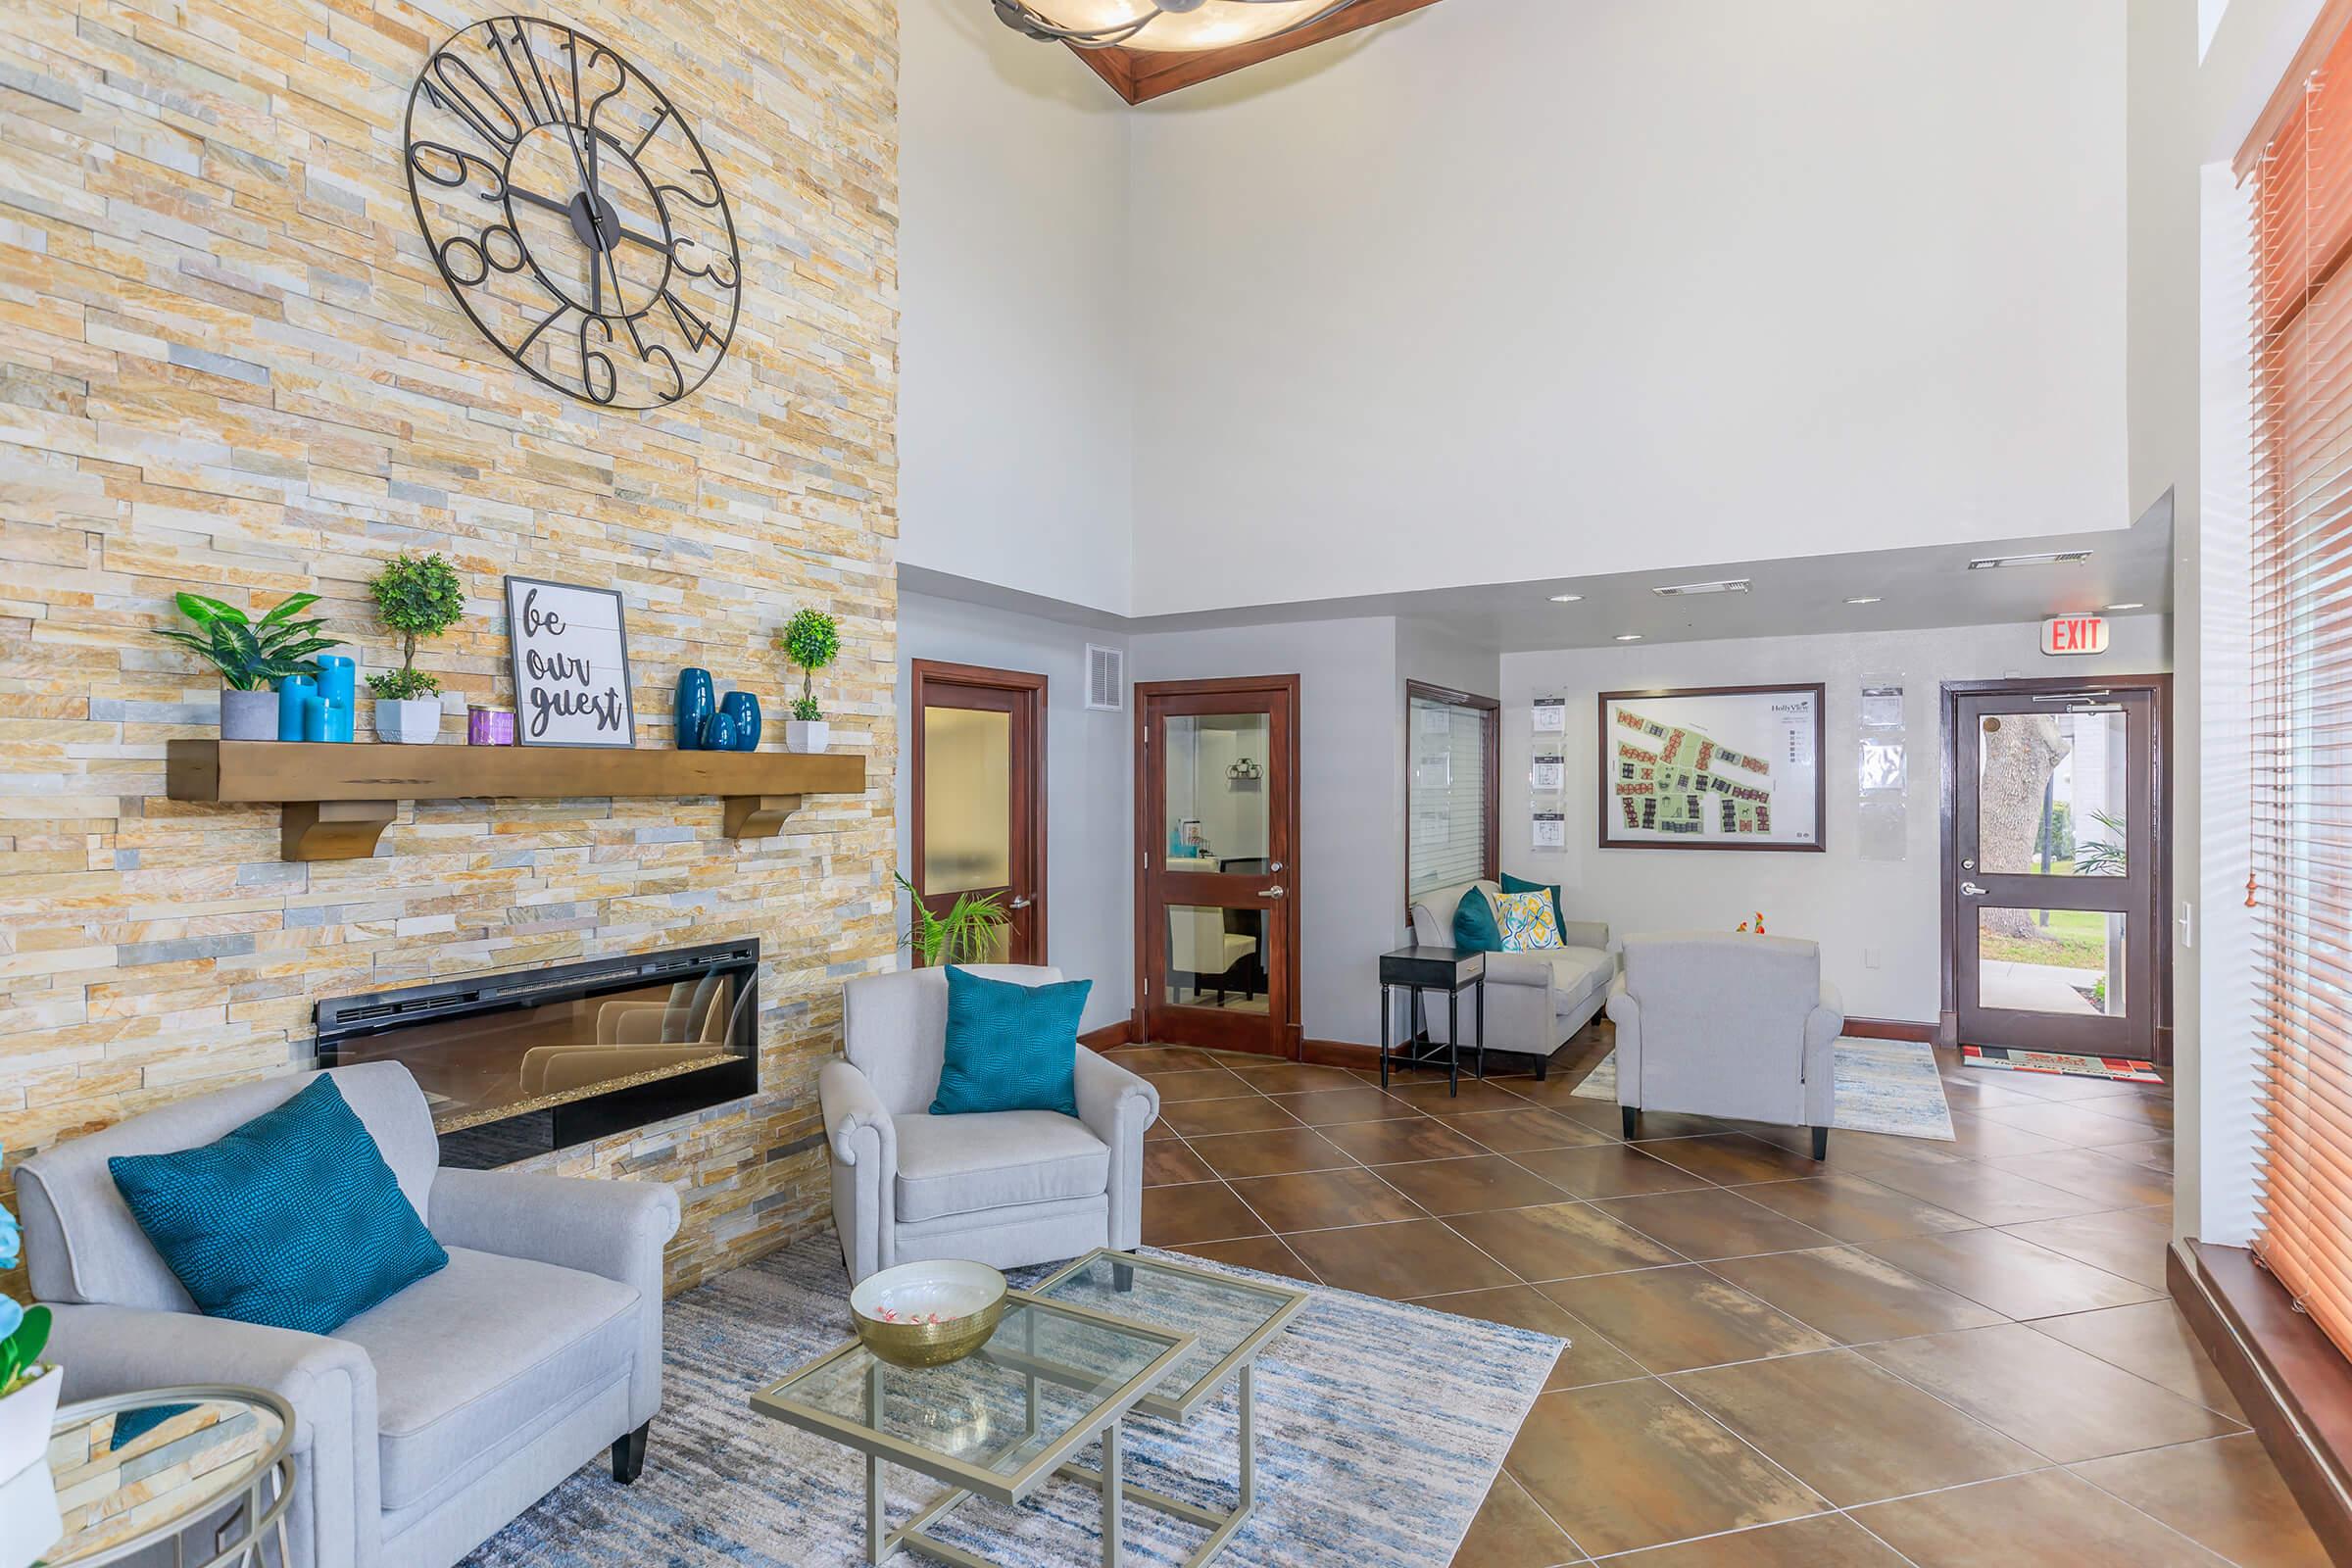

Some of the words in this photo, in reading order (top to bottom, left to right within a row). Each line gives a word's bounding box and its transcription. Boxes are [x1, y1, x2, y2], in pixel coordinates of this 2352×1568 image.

[486, 16, 558, 126] 11
[561, 29, 625, 146] 12
[421, 52, 522, 160] 10
[632, 105, 672, 160] 1
[410, 140, 507, 201] 9
[657, 169, 723, 222] 2
[440, 223, 526, 286] 8
[671, 237, 740, 289] 3
[514, 274, 572, 360] 7
[662, 289, 727, 353] 4
[580, 314, 616, 404] 6
[626, 311, 684, 402] 5
[523, 588, 565, 638] be
[2052, 618, 2101, 651] EXIT
[526, 648, 590, 687] our
[530, 686, 622, 737] guest
